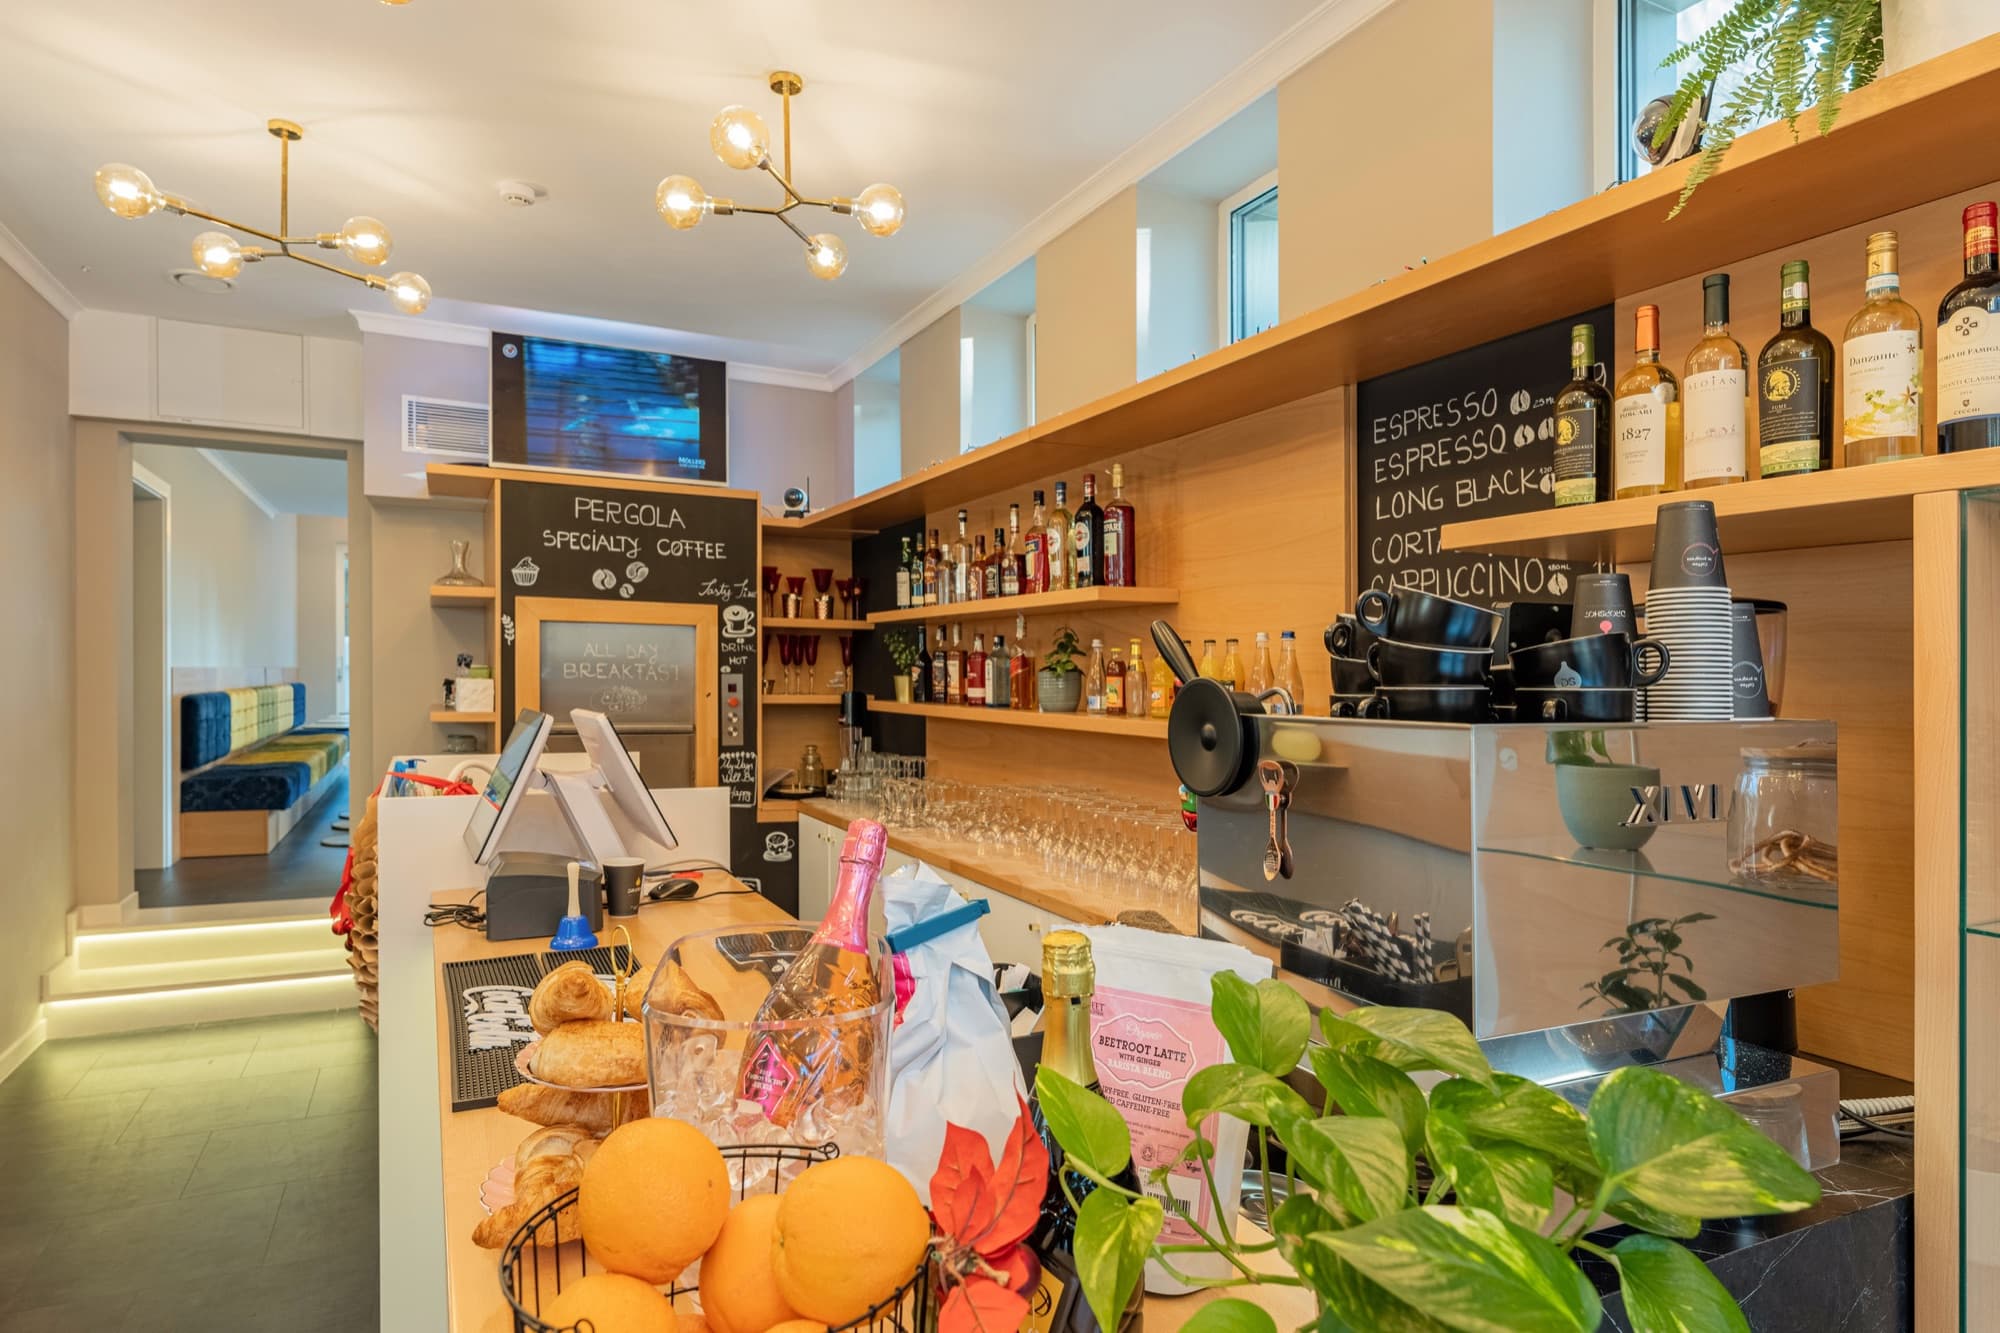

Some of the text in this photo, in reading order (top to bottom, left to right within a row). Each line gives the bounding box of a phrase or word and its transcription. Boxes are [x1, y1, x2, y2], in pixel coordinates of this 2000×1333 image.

[1373, 388, 1498, 445] ESPRESSO
[1621, 427, 1652, 441] 1827
[1374, 424, 1508, 484] ESPRESSO
[1376, 484, 1444, 520] LONG
[1456, 466, 1539, 508] BLACK
[575, 497, 687, 529] PERGOLA
[543, 529, 728, 559] SPECIALTY COFFEE
[698, 578, 731, 602] Tasty
[583, 641, 617, 658] ALL
[721, 641, 756, 653] DRINK
[728, 656, 748, 665] HOT
[1098, 1034, 1187, 1063] BEETROOT LATTE
[1118, 1051, 1162, 1067] WITH GINGER
[1115, 1099, 1170, 1119] CAFFEINE-FREE
[1132, 1092, 1181, 1112] GLUTEN-FREE
